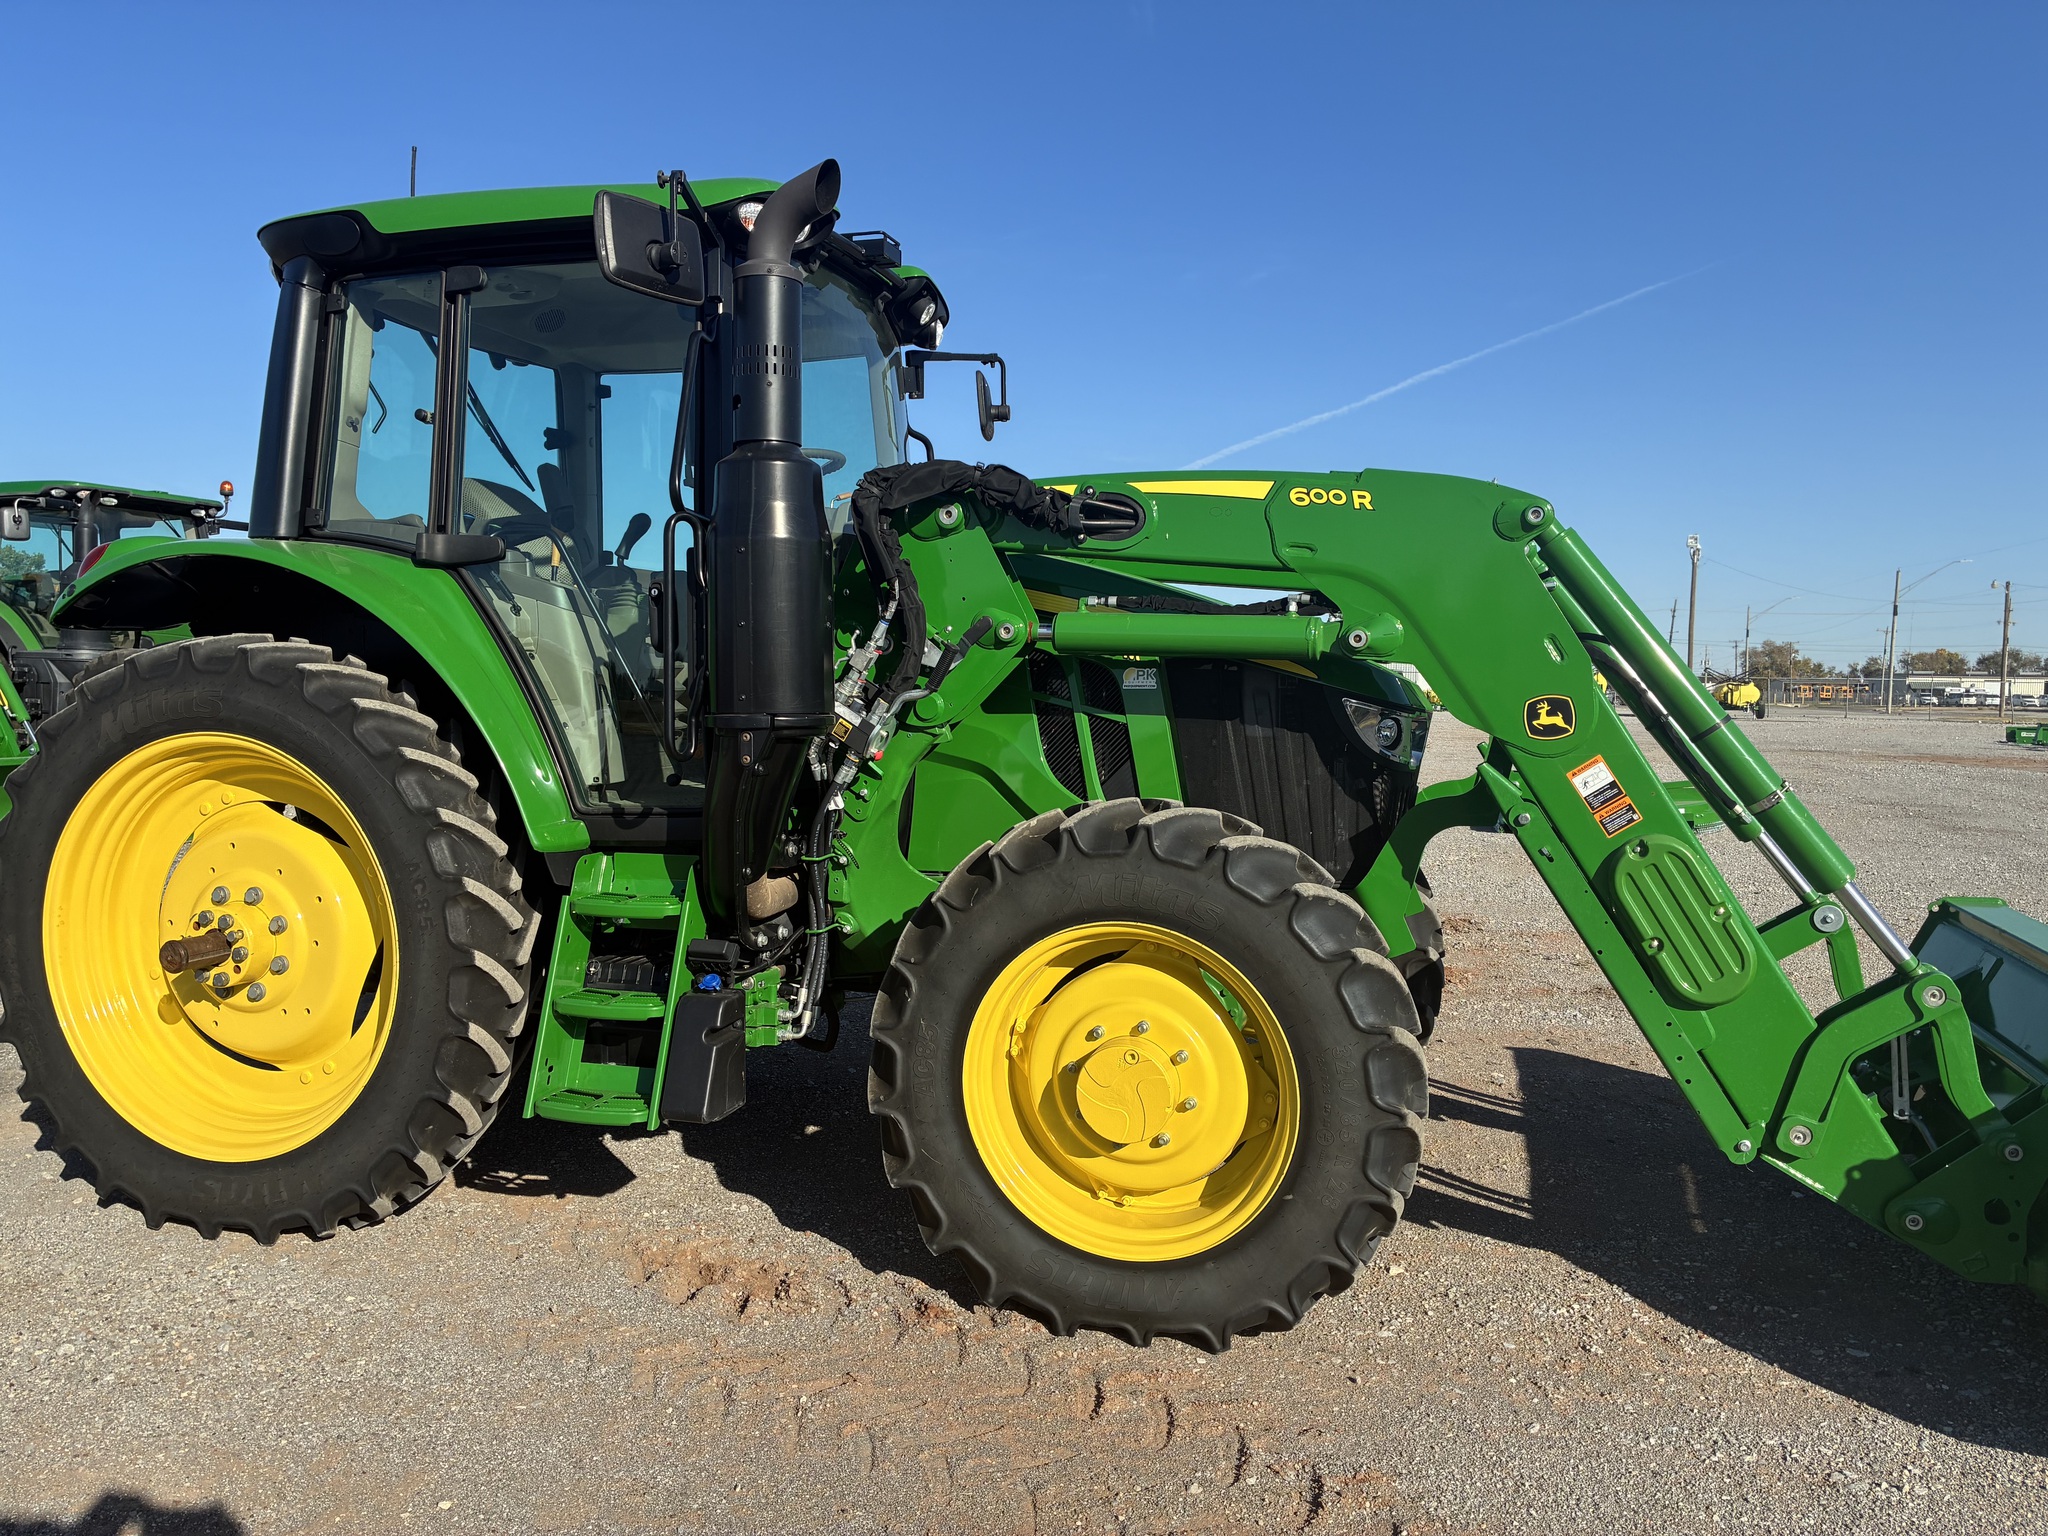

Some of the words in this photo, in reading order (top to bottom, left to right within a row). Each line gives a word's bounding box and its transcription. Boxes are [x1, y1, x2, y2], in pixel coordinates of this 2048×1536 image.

[1289, 487, 1347, 507] 600
[1351, 489, 1376, 511] R
[1136, 669, 1156, 681] PK
[1576, 758, 1599, 774] WARNING
[1604, 800, 1627, 815] WARNING
[1062, 872, 1225, 932] Mitas
[912, 1017, 940, 1099] AC85
[1331, 1044, 1362, 1146] 320/85
[1320, 1177, 1349, 1211] 28
